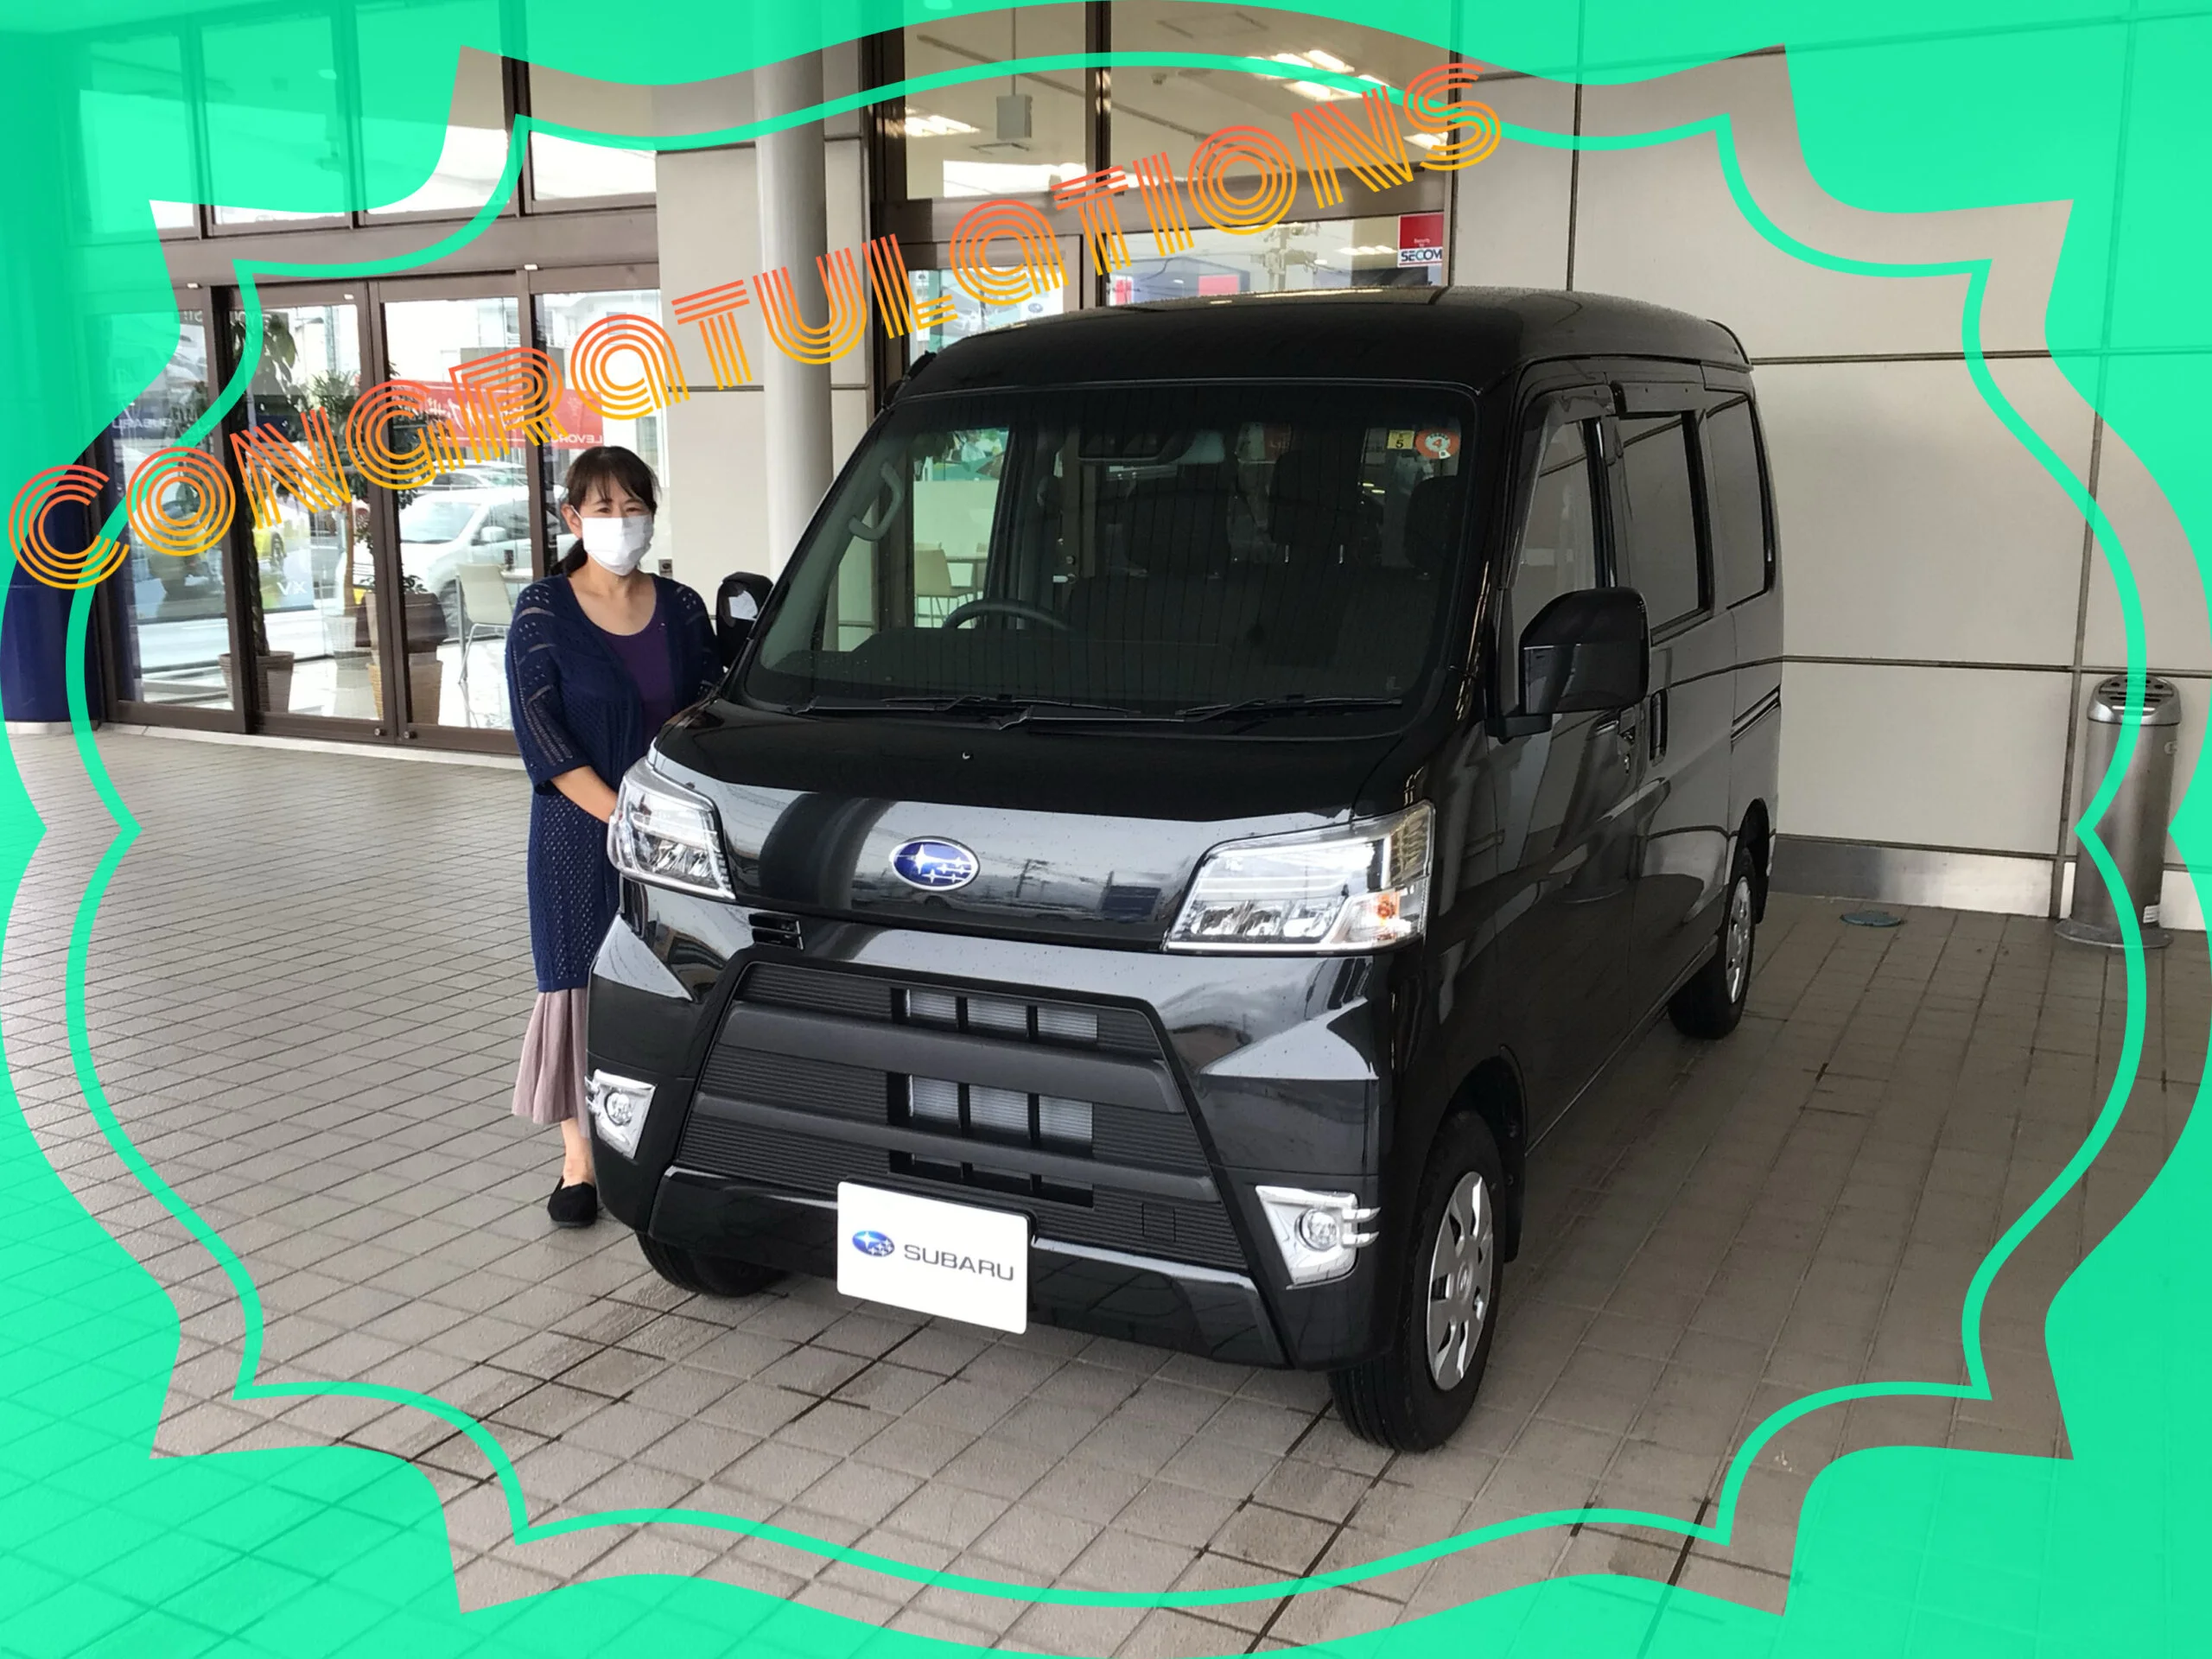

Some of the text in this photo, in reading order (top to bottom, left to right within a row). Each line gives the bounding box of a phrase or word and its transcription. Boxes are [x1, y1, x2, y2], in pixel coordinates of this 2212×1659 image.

[1401, 248, 1442, 261] SECOM
[1395, 439, 1404, 448] 5
[903, 1243, 1014, 1281] SUBARU
